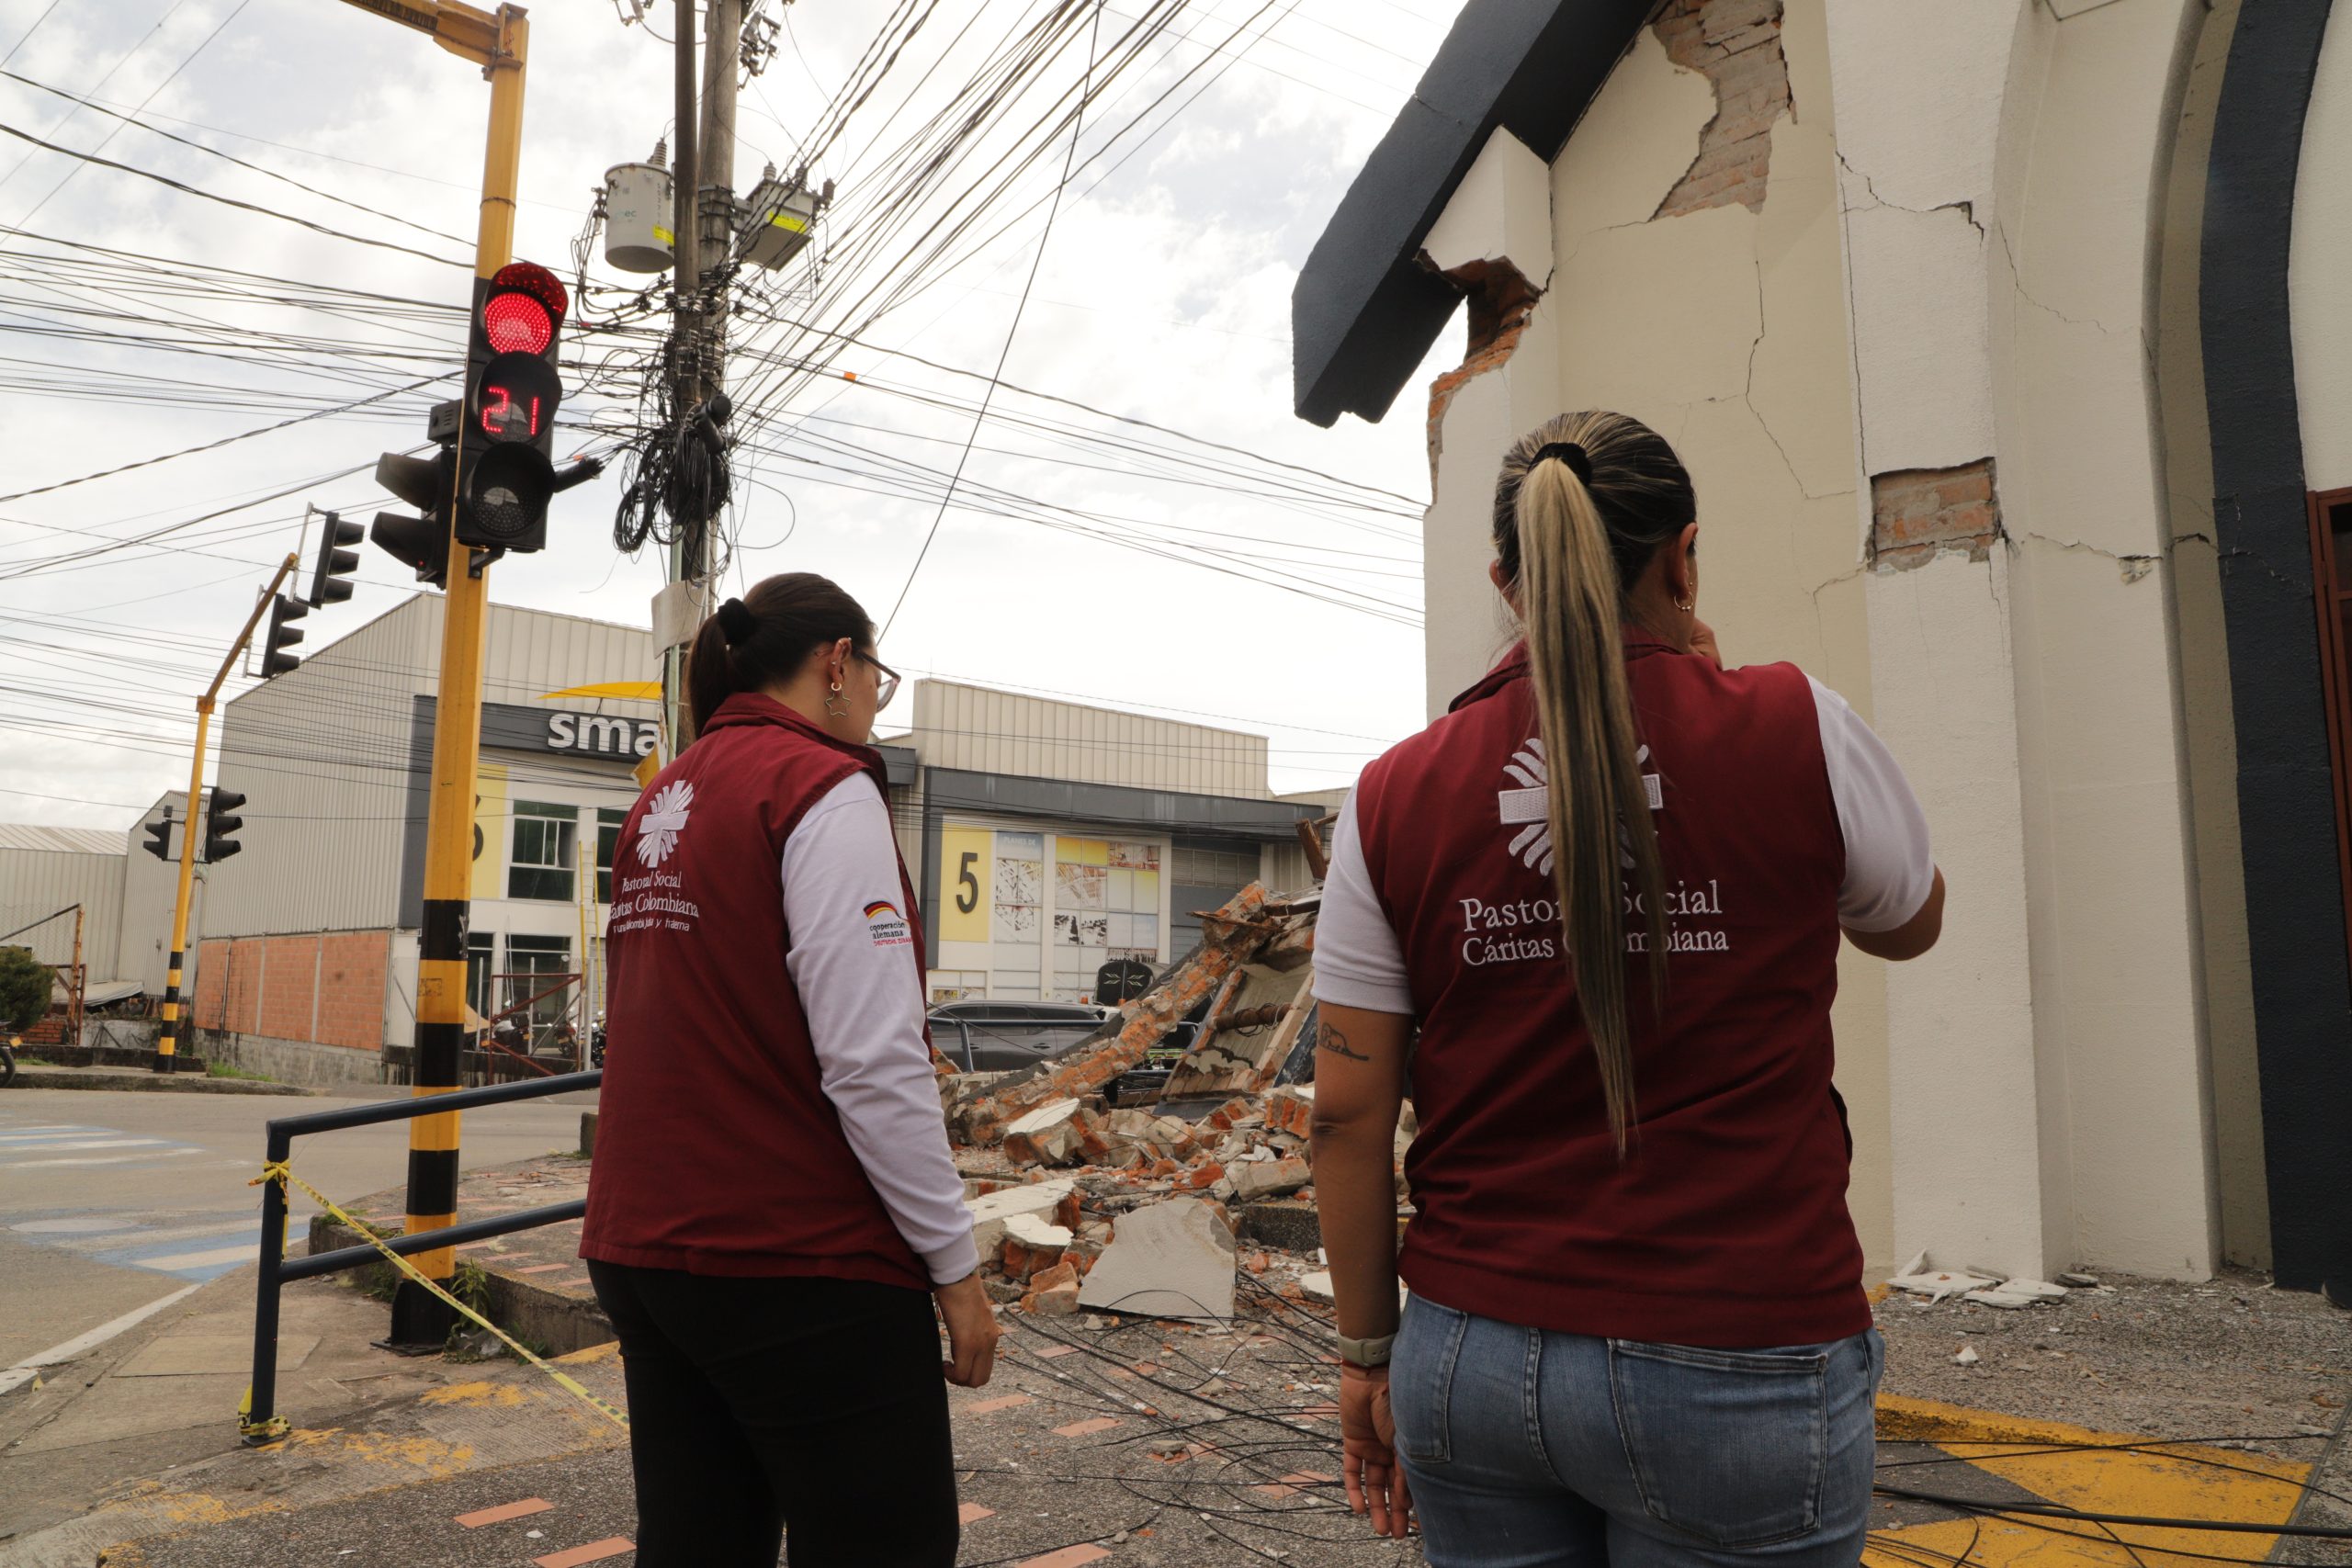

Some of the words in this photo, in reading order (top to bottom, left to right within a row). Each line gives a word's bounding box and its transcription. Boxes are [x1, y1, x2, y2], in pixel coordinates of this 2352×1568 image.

[482, 387, 539, 436] 21
[654, 870, 682, 888] Social
[956, 852, 978, 914] 5
[635, 891, 699, 918] Colombiana
[872, 930, 904, 939] alemana
[1463, 932, 1555, 965] Cáritas
